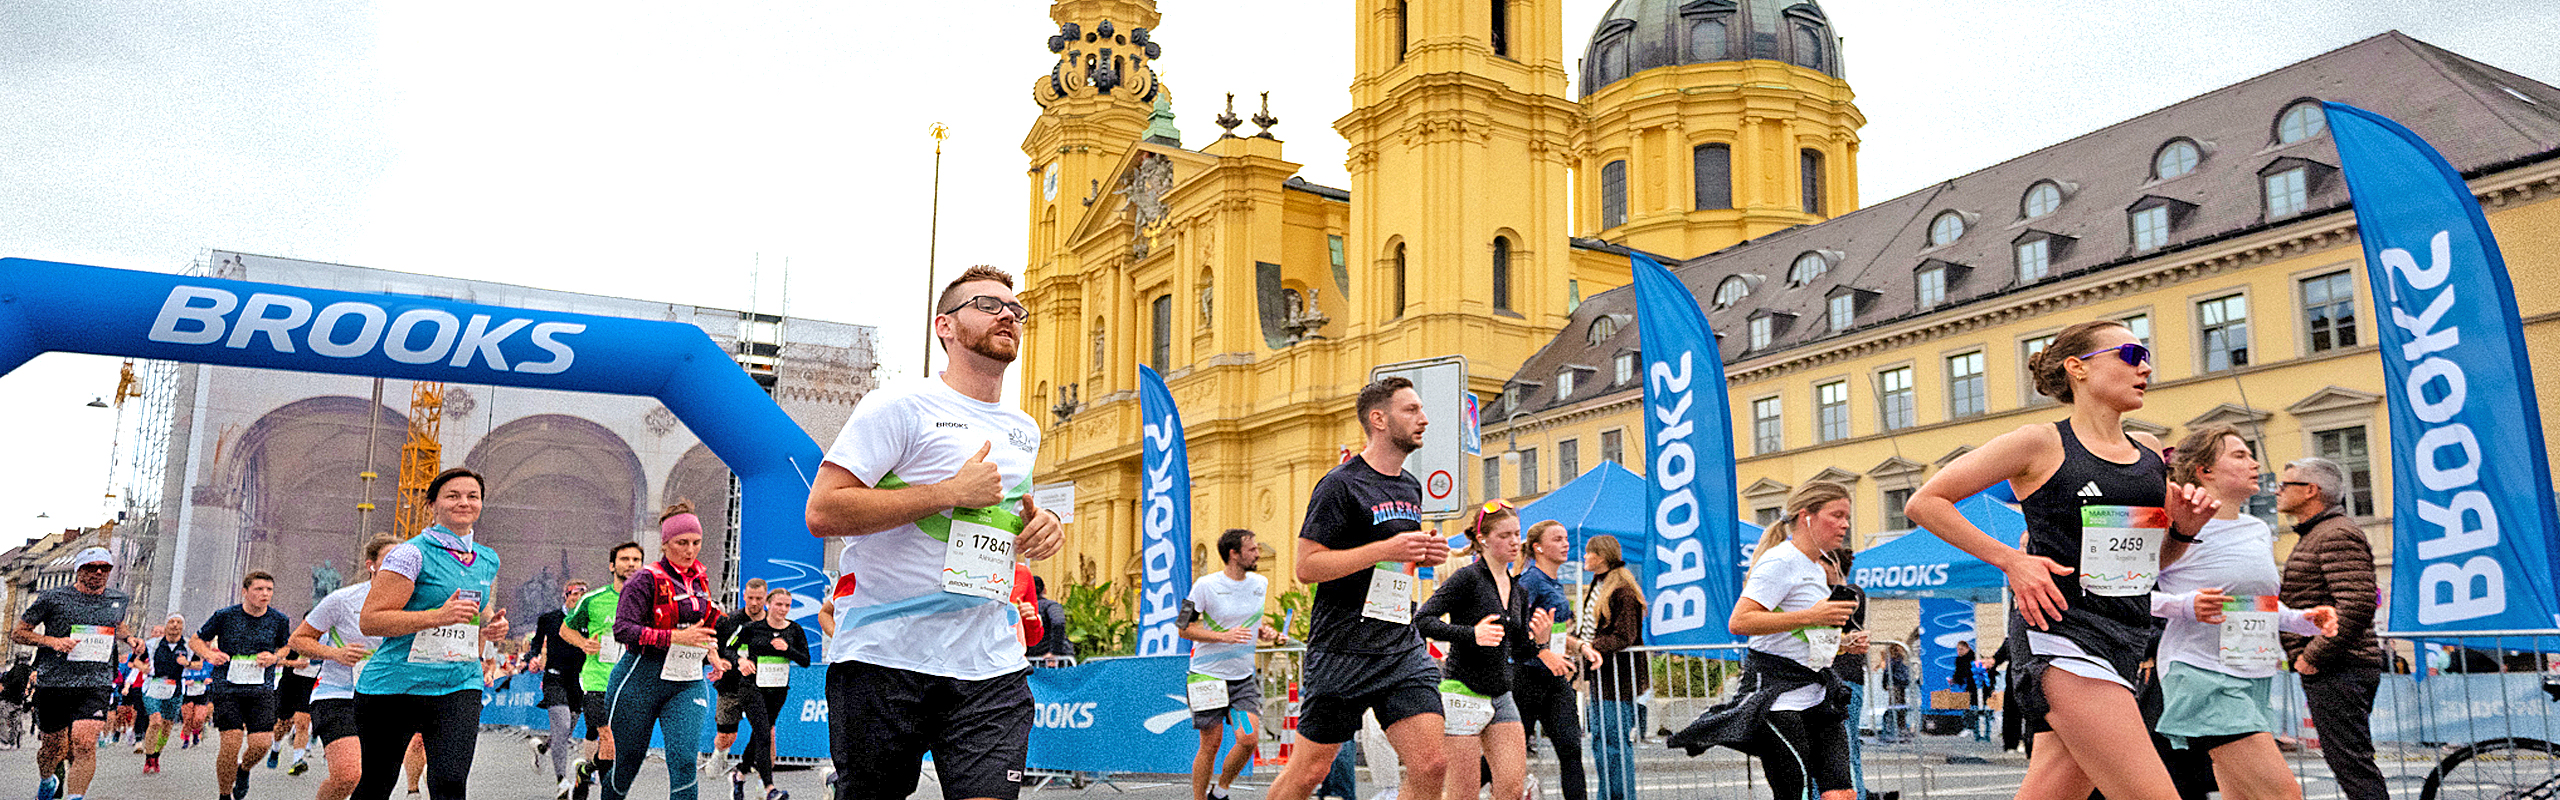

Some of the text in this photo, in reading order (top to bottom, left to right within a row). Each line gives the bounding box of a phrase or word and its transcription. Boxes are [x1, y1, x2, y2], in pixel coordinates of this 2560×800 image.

[148, 285, 586, 375] BROOKS
[936, 421, 968, 430] BROOKS
[955, 534, 1011, 556] D 17847
[2090, 537, 2143, 553] B 2459
[1393, 579, 1407, 591] 137
[1855, 563, 1949, 588] BROOKS
